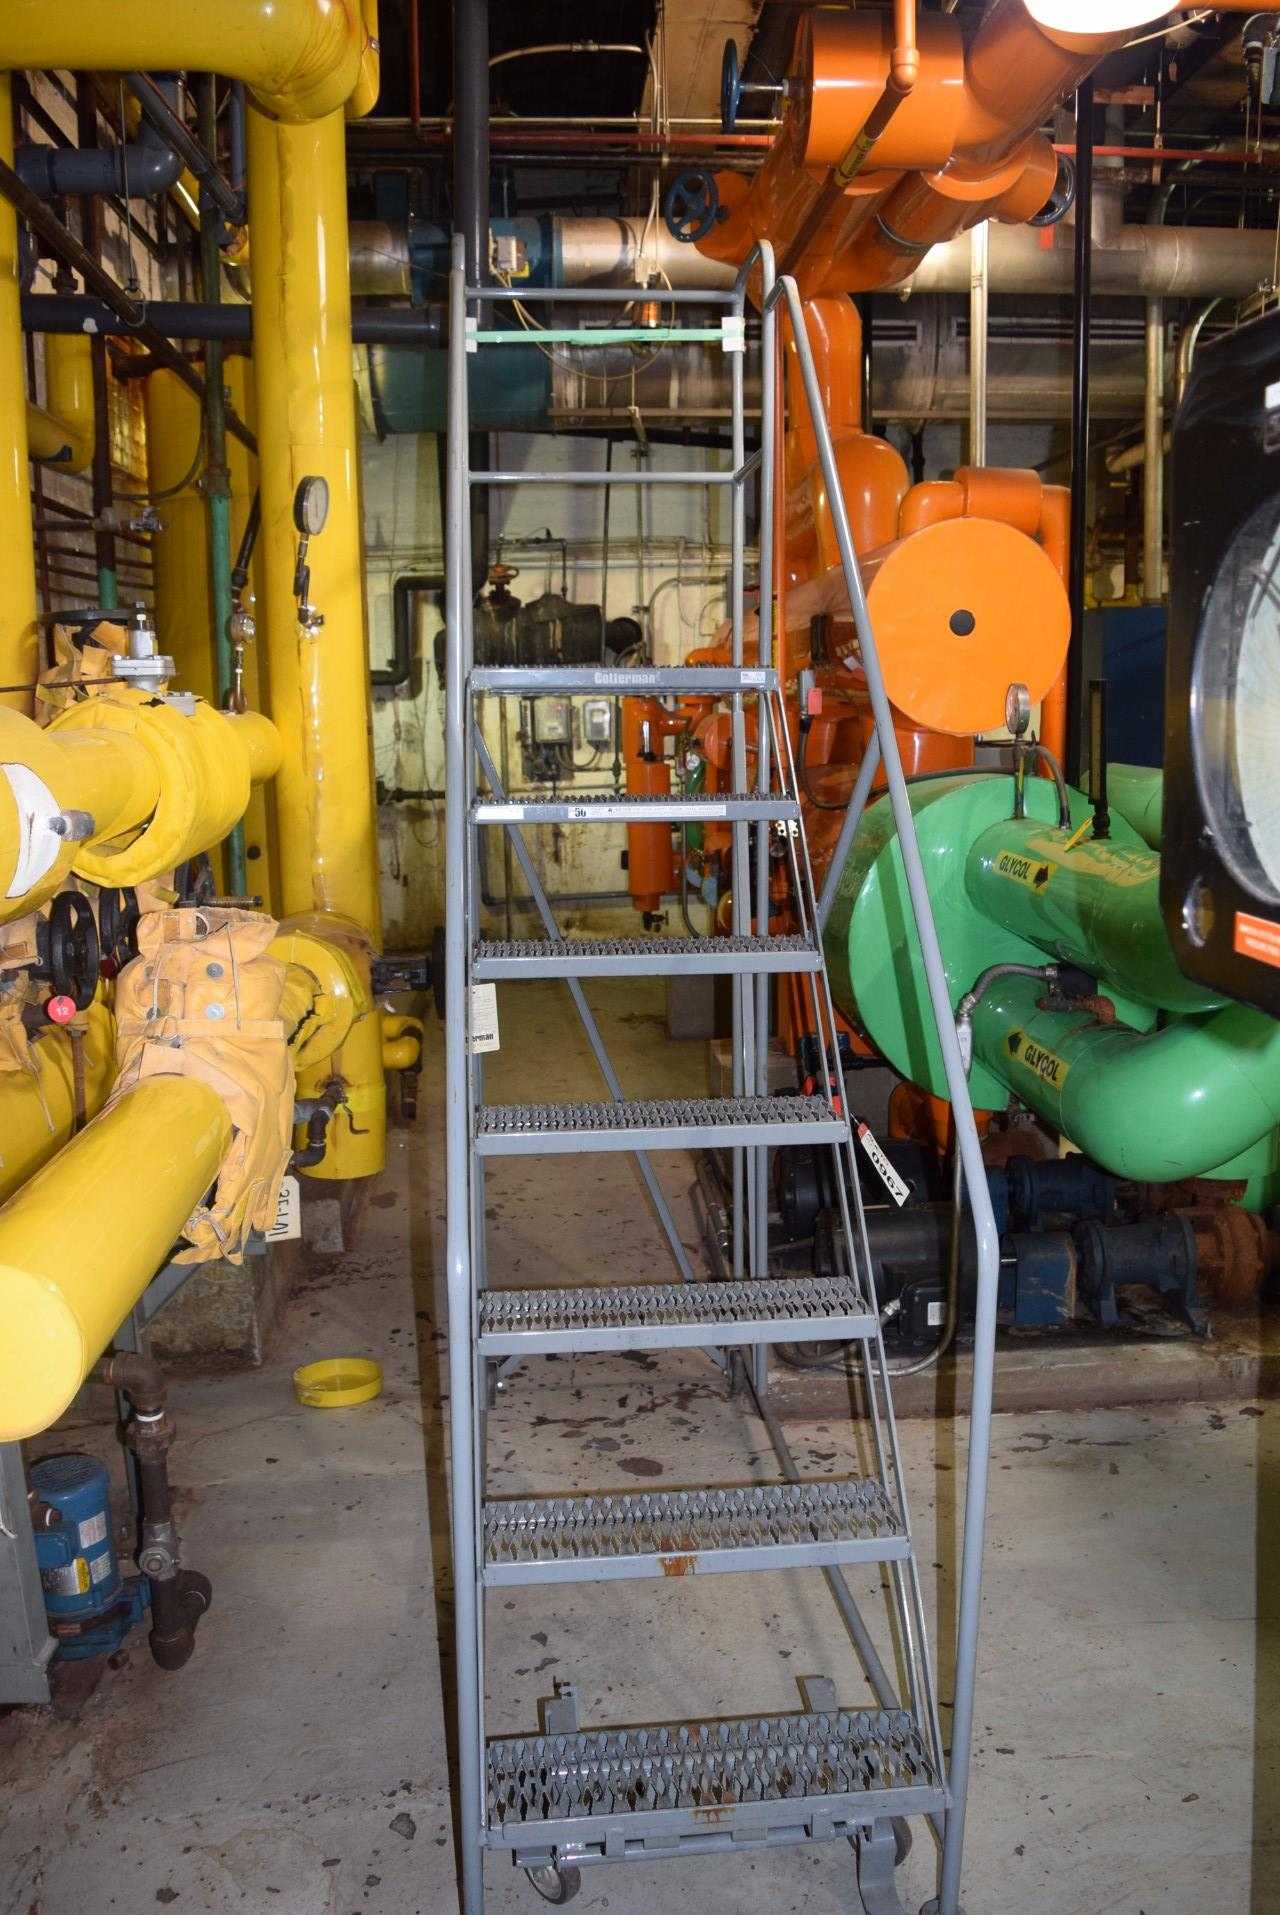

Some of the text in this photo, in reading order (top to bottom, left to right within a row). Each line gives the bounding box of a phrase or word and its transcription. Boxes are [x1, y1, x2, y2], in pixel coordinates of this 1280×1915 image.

[594, 671, 656, 685] Cotterman
[999, 854, 1031, 880] GLYCOL
[1024, 1044, 1060, 1081] GLYCOL
